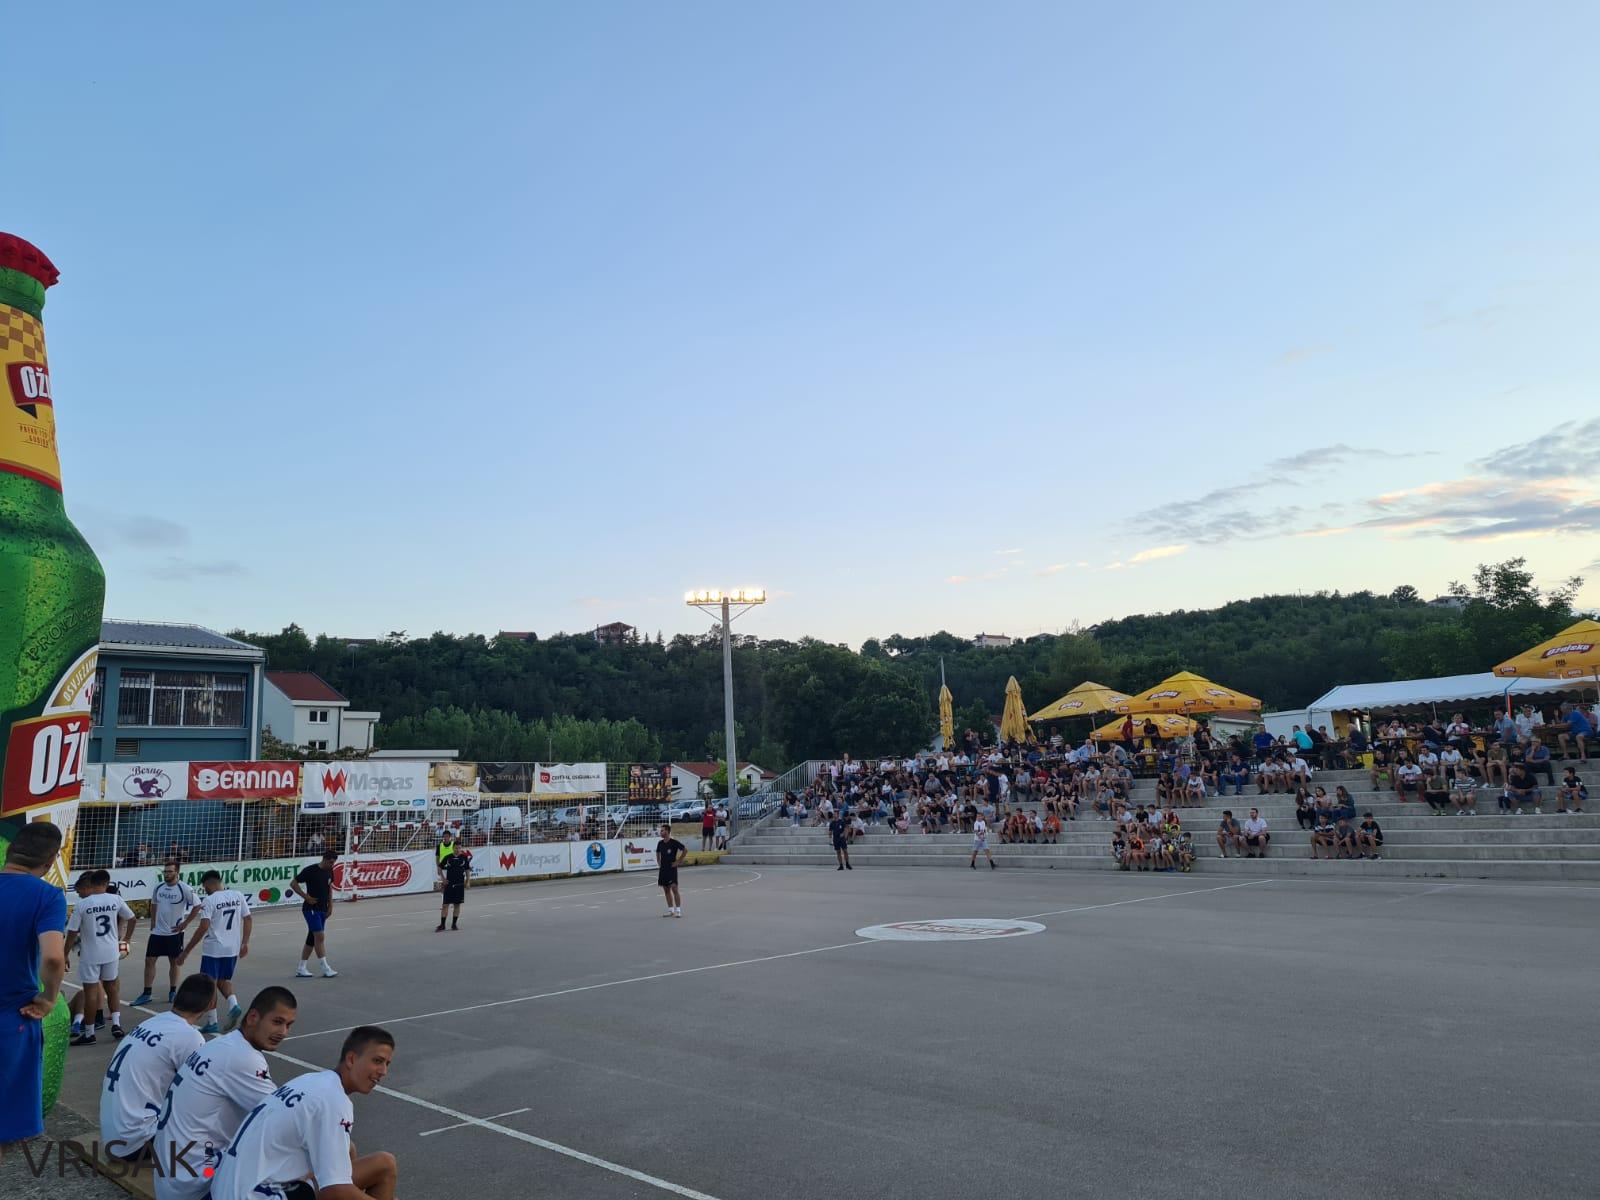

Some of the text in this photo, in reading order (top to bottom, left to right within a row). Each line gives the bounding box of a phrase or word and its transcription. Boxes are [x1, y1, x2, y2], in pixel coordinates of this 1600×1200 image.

[193, 768, 295, 792] BERNINA
[348, 773, 414, 797] Mepas
[520, 852, 561, 868] Mepas
[243, 864, 301, 883] PROMET
[95, 914, 111, 937] 3
[222, 909, 236, 931] 7
[106, 1043, 132, 1092] 4
